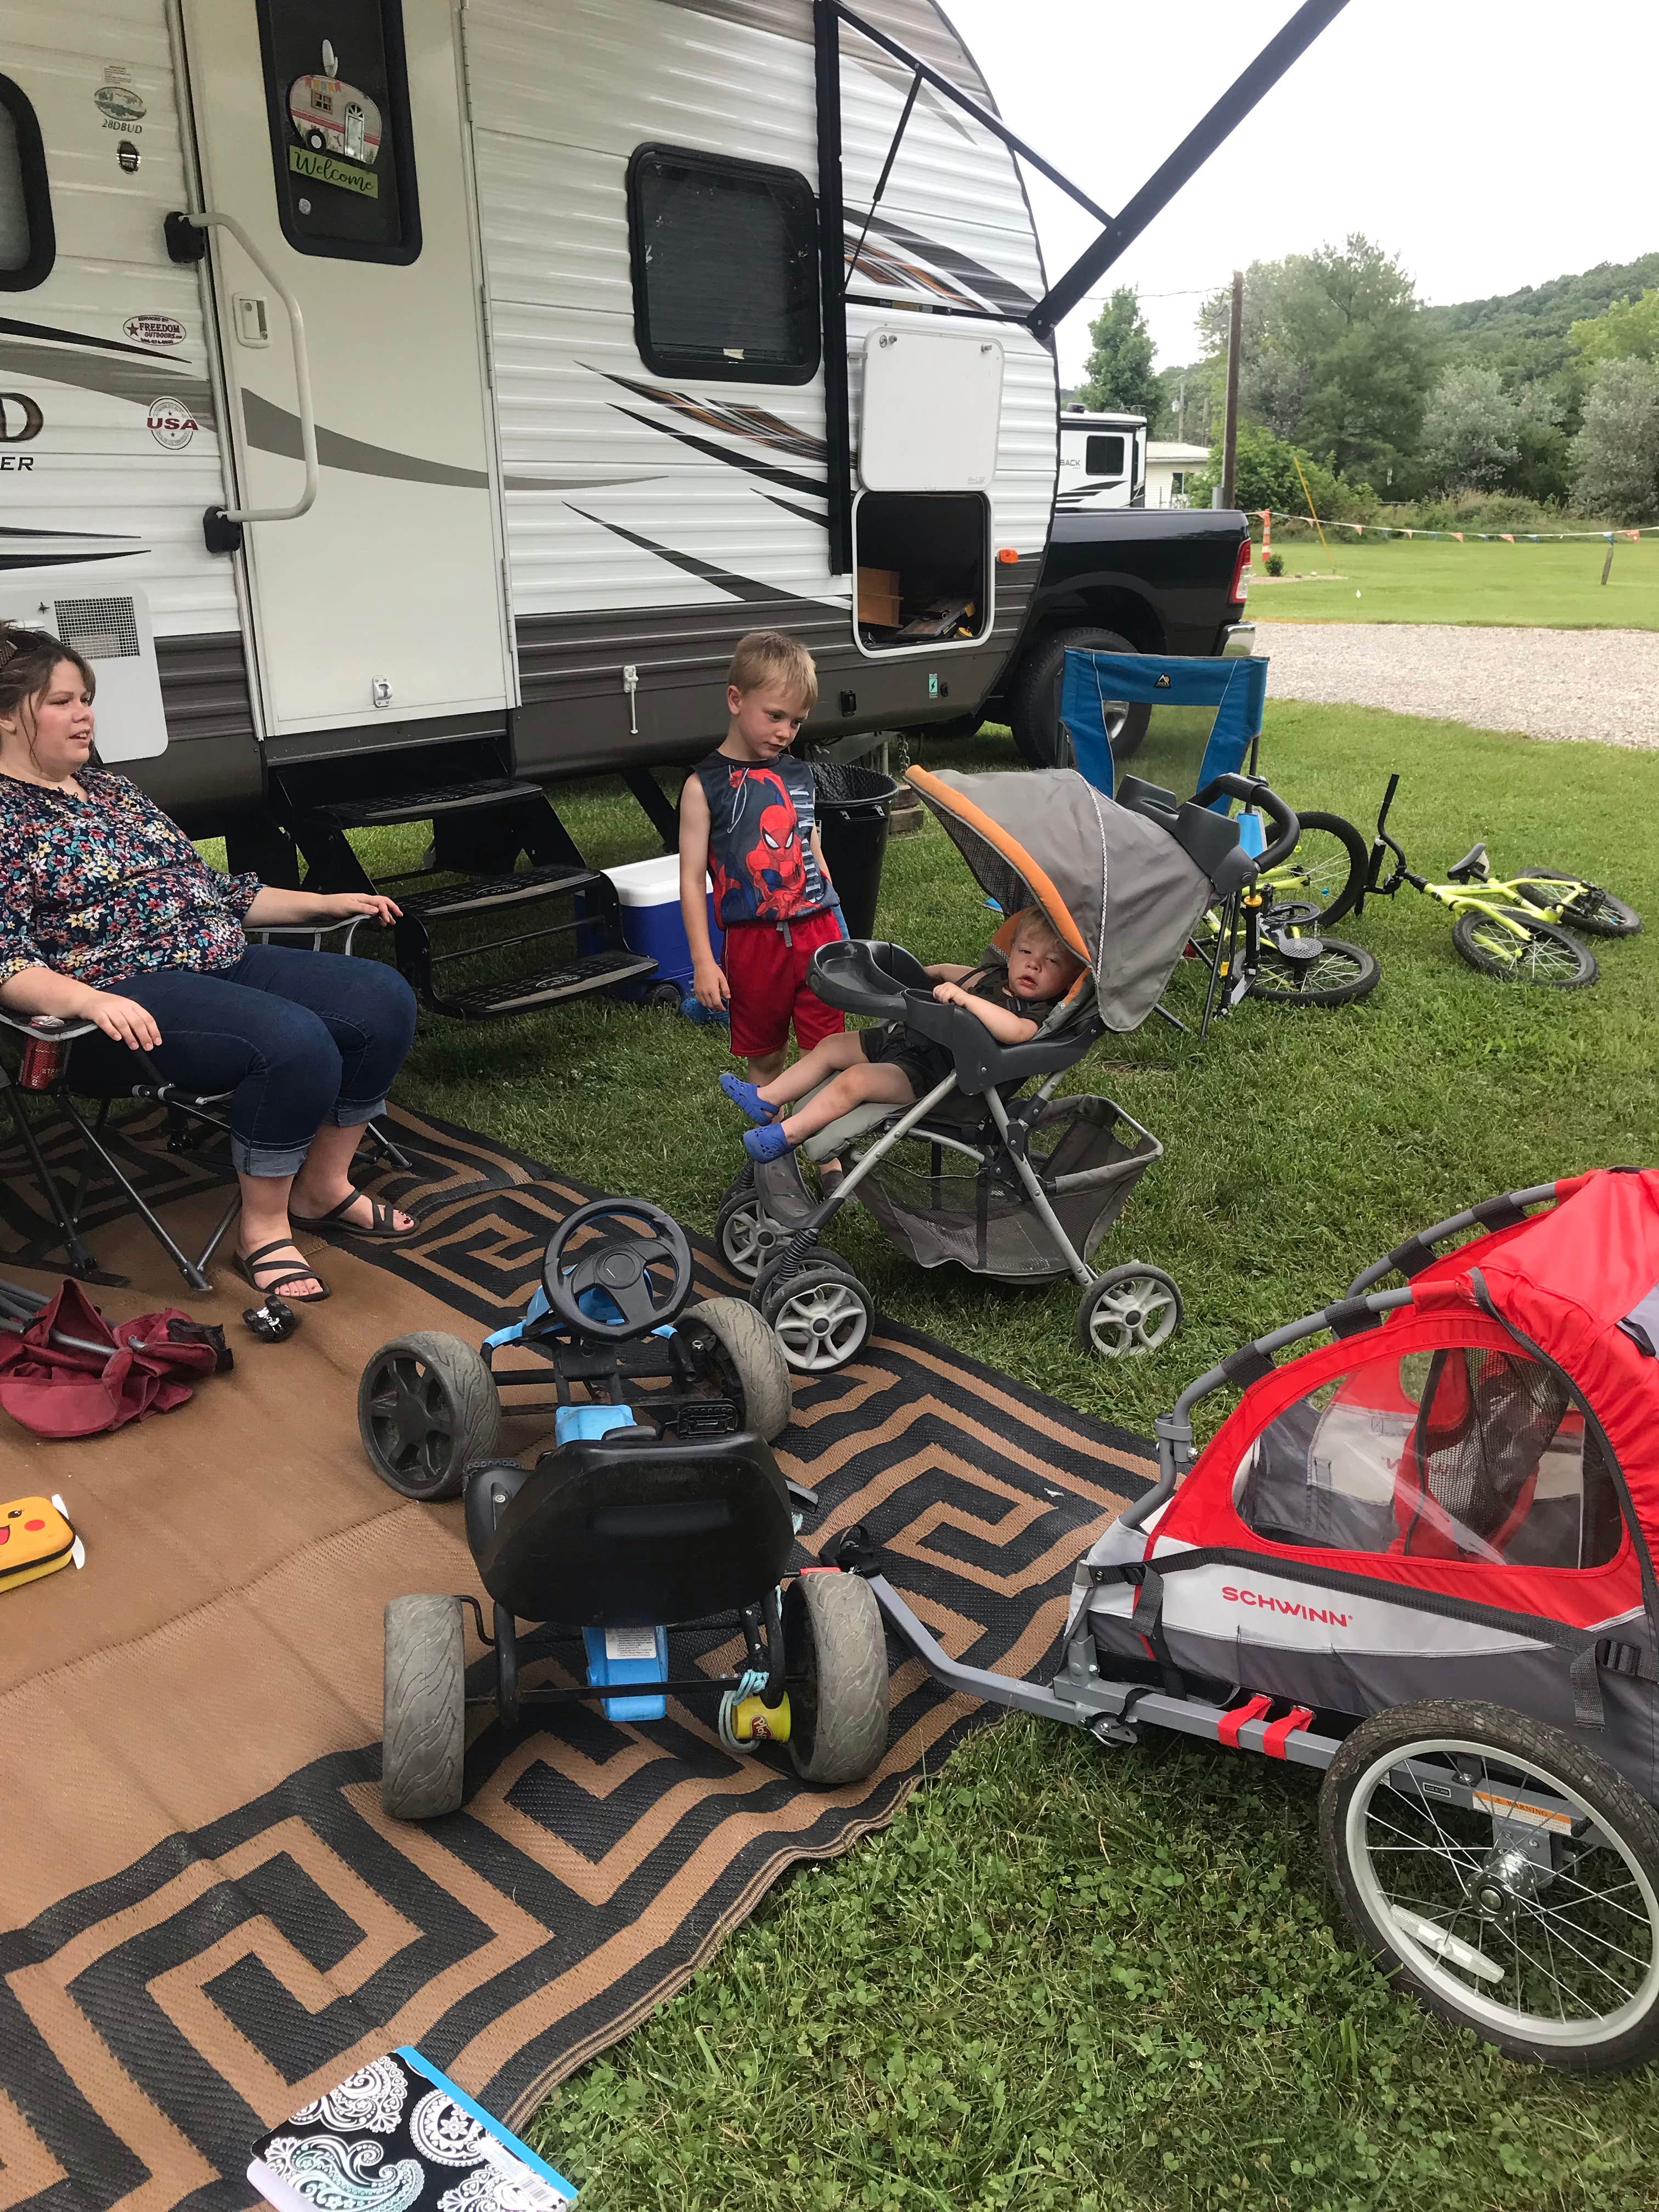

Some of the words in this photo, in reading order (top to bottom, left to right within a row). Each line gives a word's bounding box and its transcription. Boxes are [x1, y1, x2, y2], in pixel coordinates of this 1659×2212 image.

[101, 119, 143, 134] 28DBUD
[294, 151, 374, 191] Welcome
[139, 322, 180, 333] FREEDOM
[146, 417, 199, 430] USA
[1222, 1587, 1348, 1628] SCHWINN
[1506, 1800, 1548, 1817] WARNING
